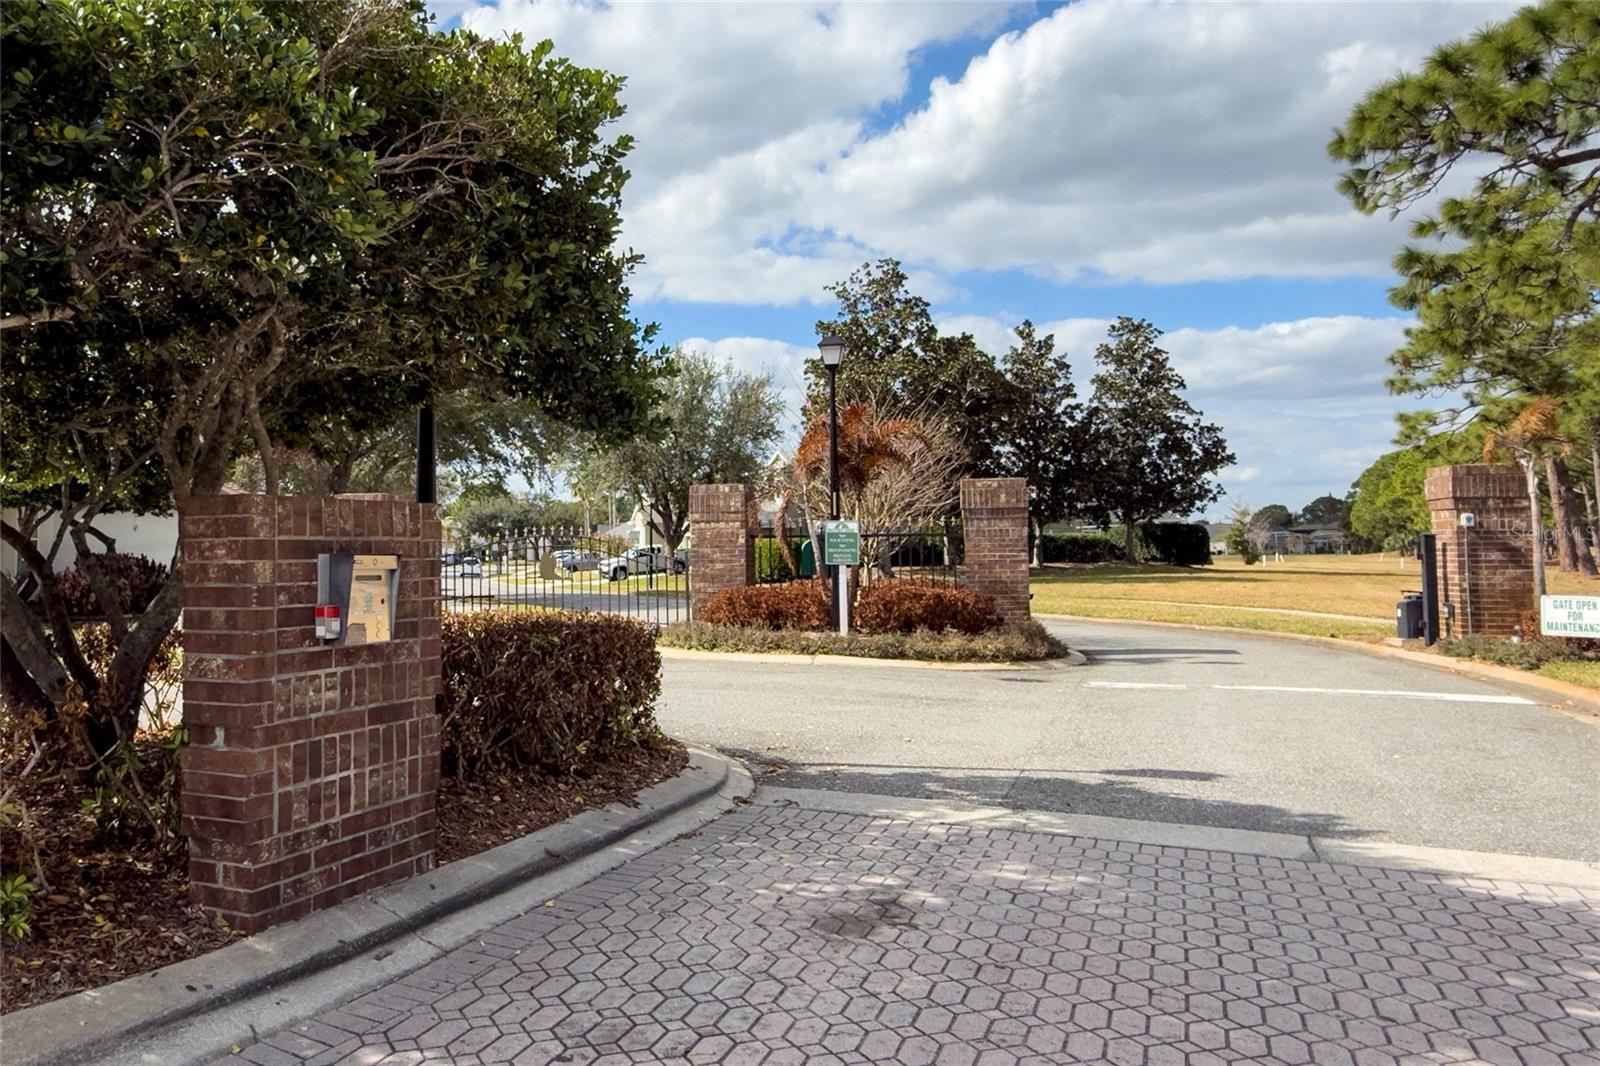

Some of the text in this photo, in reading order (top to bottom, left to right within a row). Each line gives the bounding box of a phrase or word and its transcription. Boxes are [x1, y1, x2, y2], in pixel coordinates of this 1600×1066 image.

[1552, 599, 1598, 610] GATE OPEN
[1567, 611, 1584, 621] FOR
